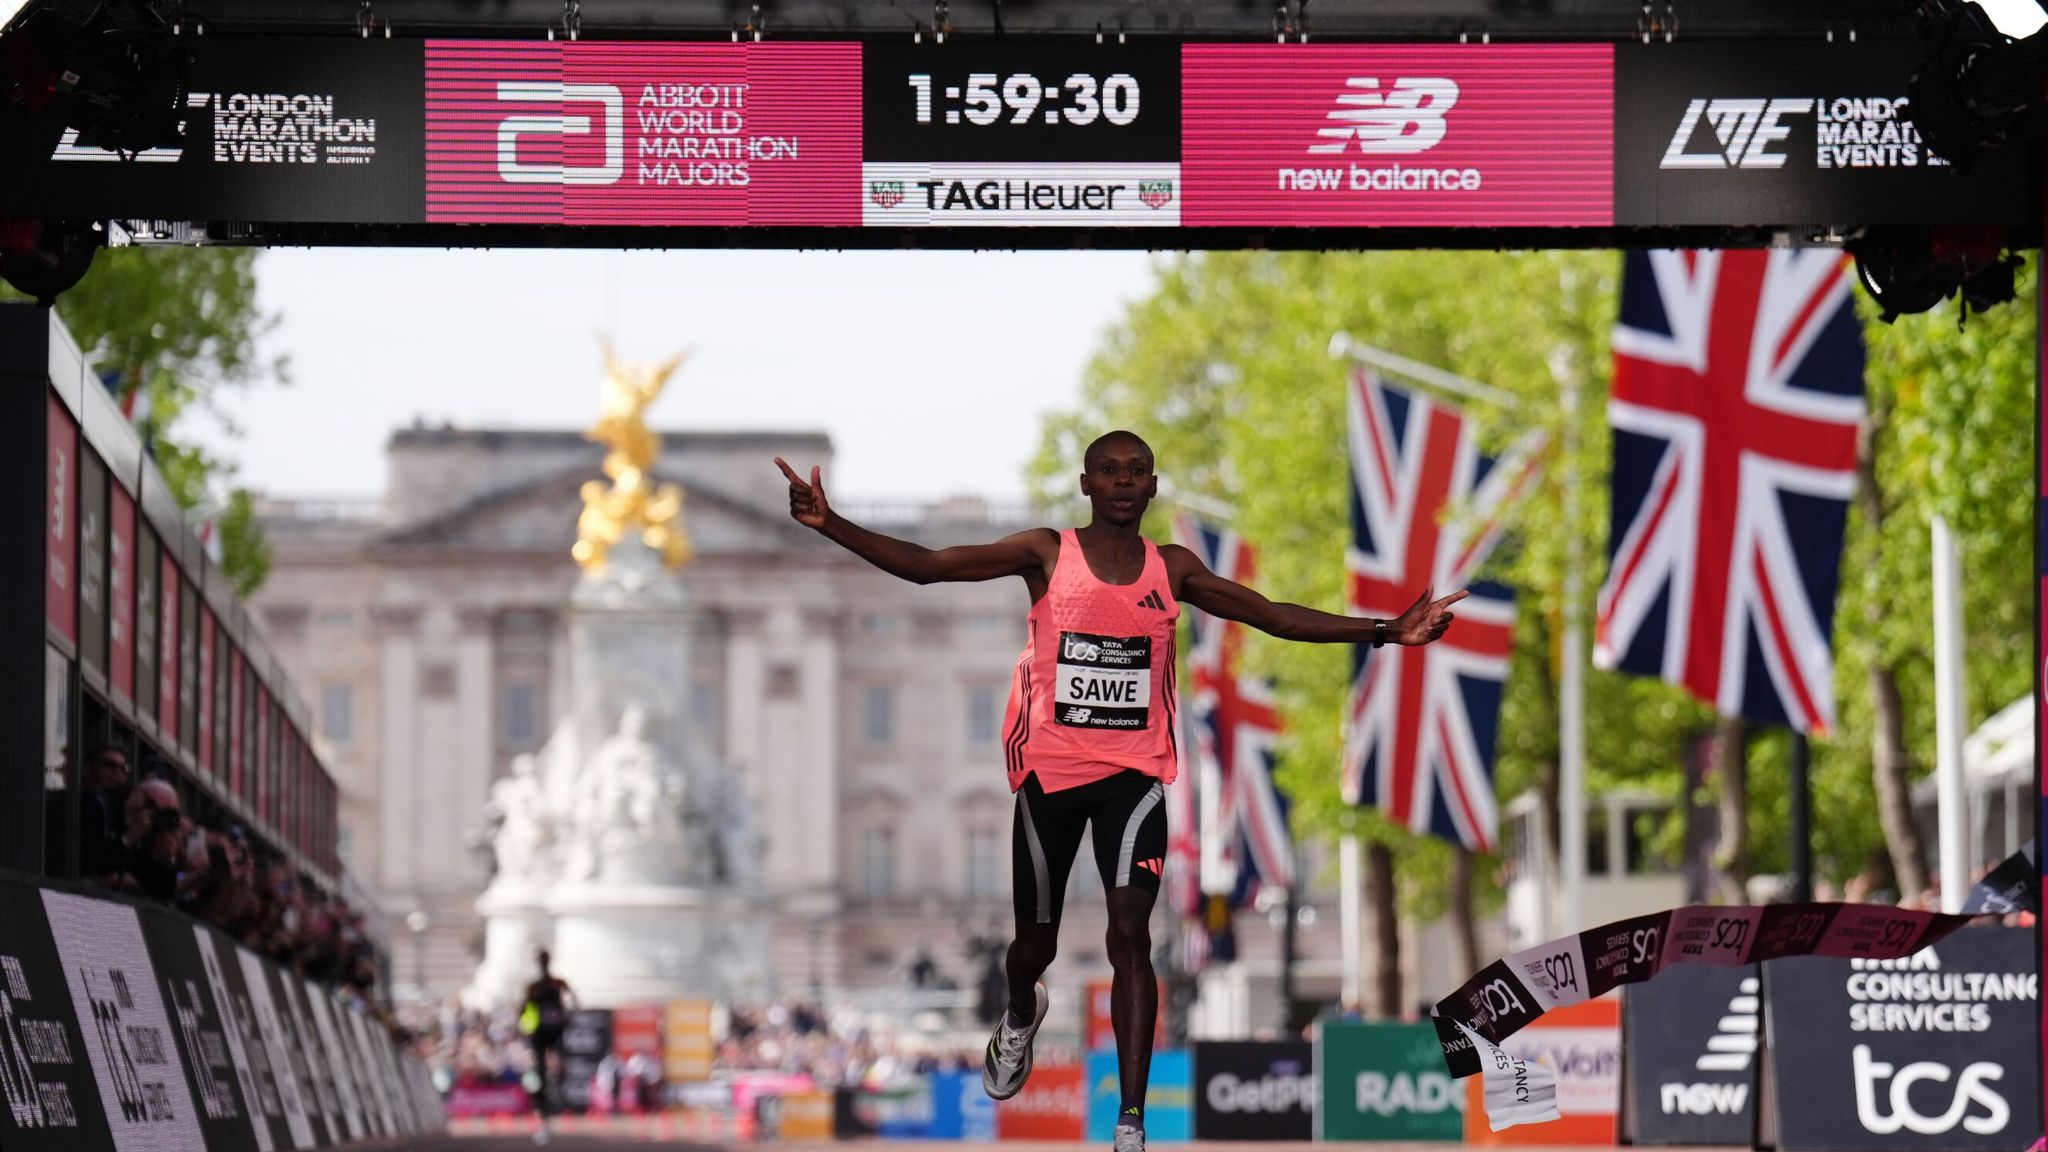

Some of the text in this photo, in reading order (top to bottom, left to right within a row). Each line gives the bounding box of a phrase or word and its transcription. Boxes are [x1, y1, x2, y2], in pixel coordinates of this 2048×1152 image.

[215, 93, 333, 117] LONDON
[638, 83, 749, 108] ABBOTT
[909, 73, 1140, 125] 1:59:30
[215, 117, 375, 141] MARATHON
[637, 110, 743, 134] WORLD
[215, 141, 317, 163] EVENTS
[638, 136, 798, 160] MARATHON
[1817, 145, 1918, 168] EVENTS
[638, 162, 749, 185] MAJORS
[1278, 163, 1481, 190] new balance
[1064, 638, 1099, 661] tcs
[1102, 641, 1122, 649] TATA
[1102, 649, 1145, 657] CONSULTANCY
[1101, 656, 1131, 664] SERVICES
[1070, 677, 1138, 702] SAWE
[1109, 718, 1139, 726] balance
[1711, 918, 1749, 957] tcs
[1545, 952, 1578, 993] tcs
[1478, 978, 1527, 1022] tcs
[1849, 1003, 1991, 1031] SERVICES
[1511, 1055, 1529, 1103] TANCY
[1853, 1044, 2010, 1134] tcs
